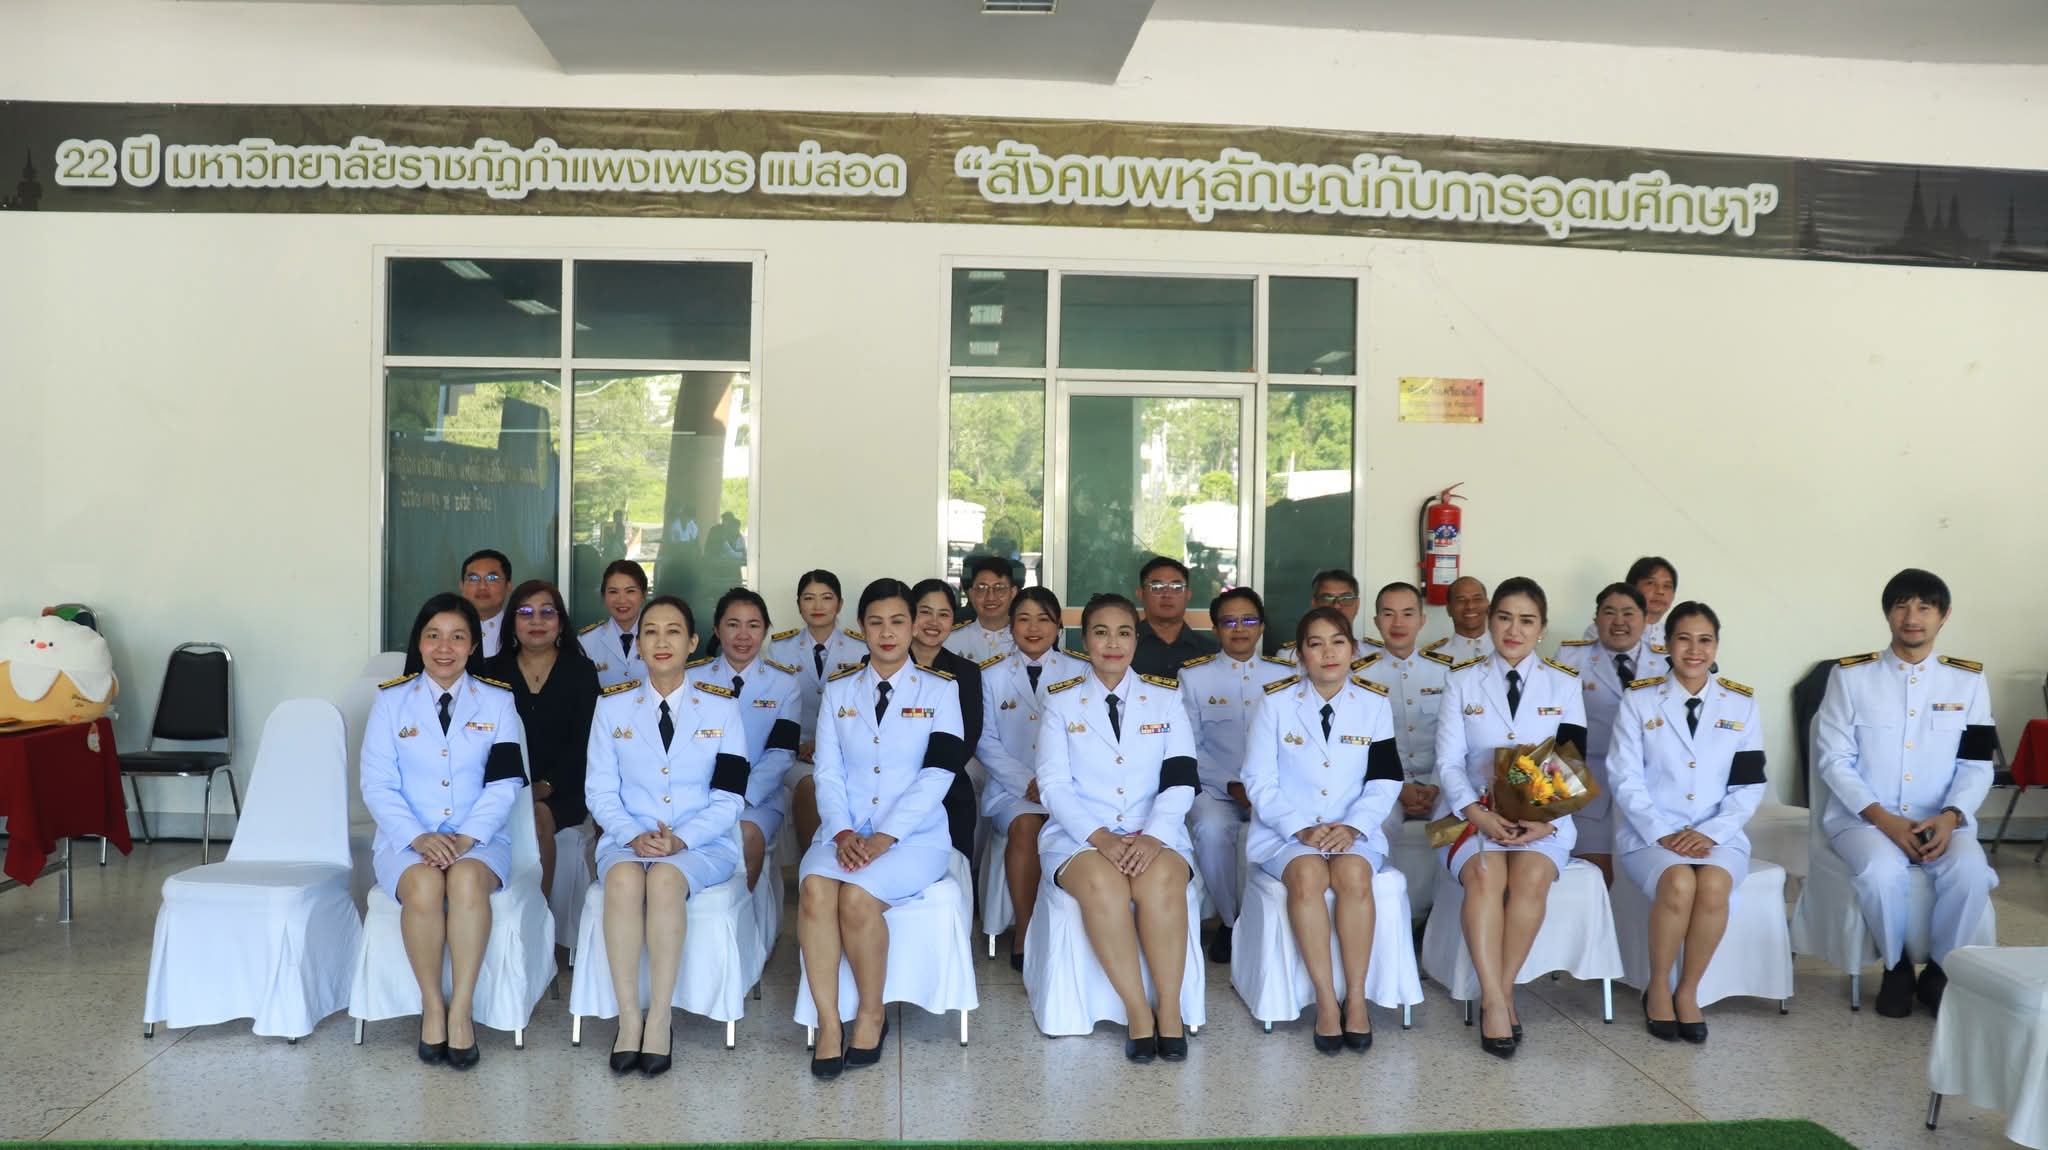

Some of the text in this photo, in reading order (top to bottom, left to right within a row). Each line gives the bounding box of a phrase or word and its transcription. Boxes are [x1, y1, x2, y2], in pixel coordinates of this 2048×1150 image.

[61, 144, 111, 180] 22
[127, 141, 153, 180] ปี
[171, 143, 749, 191] มหาวิทยาลัยราชภัฏกำแพงเพชร
[766, 147, 900, 189] แม่สอด
